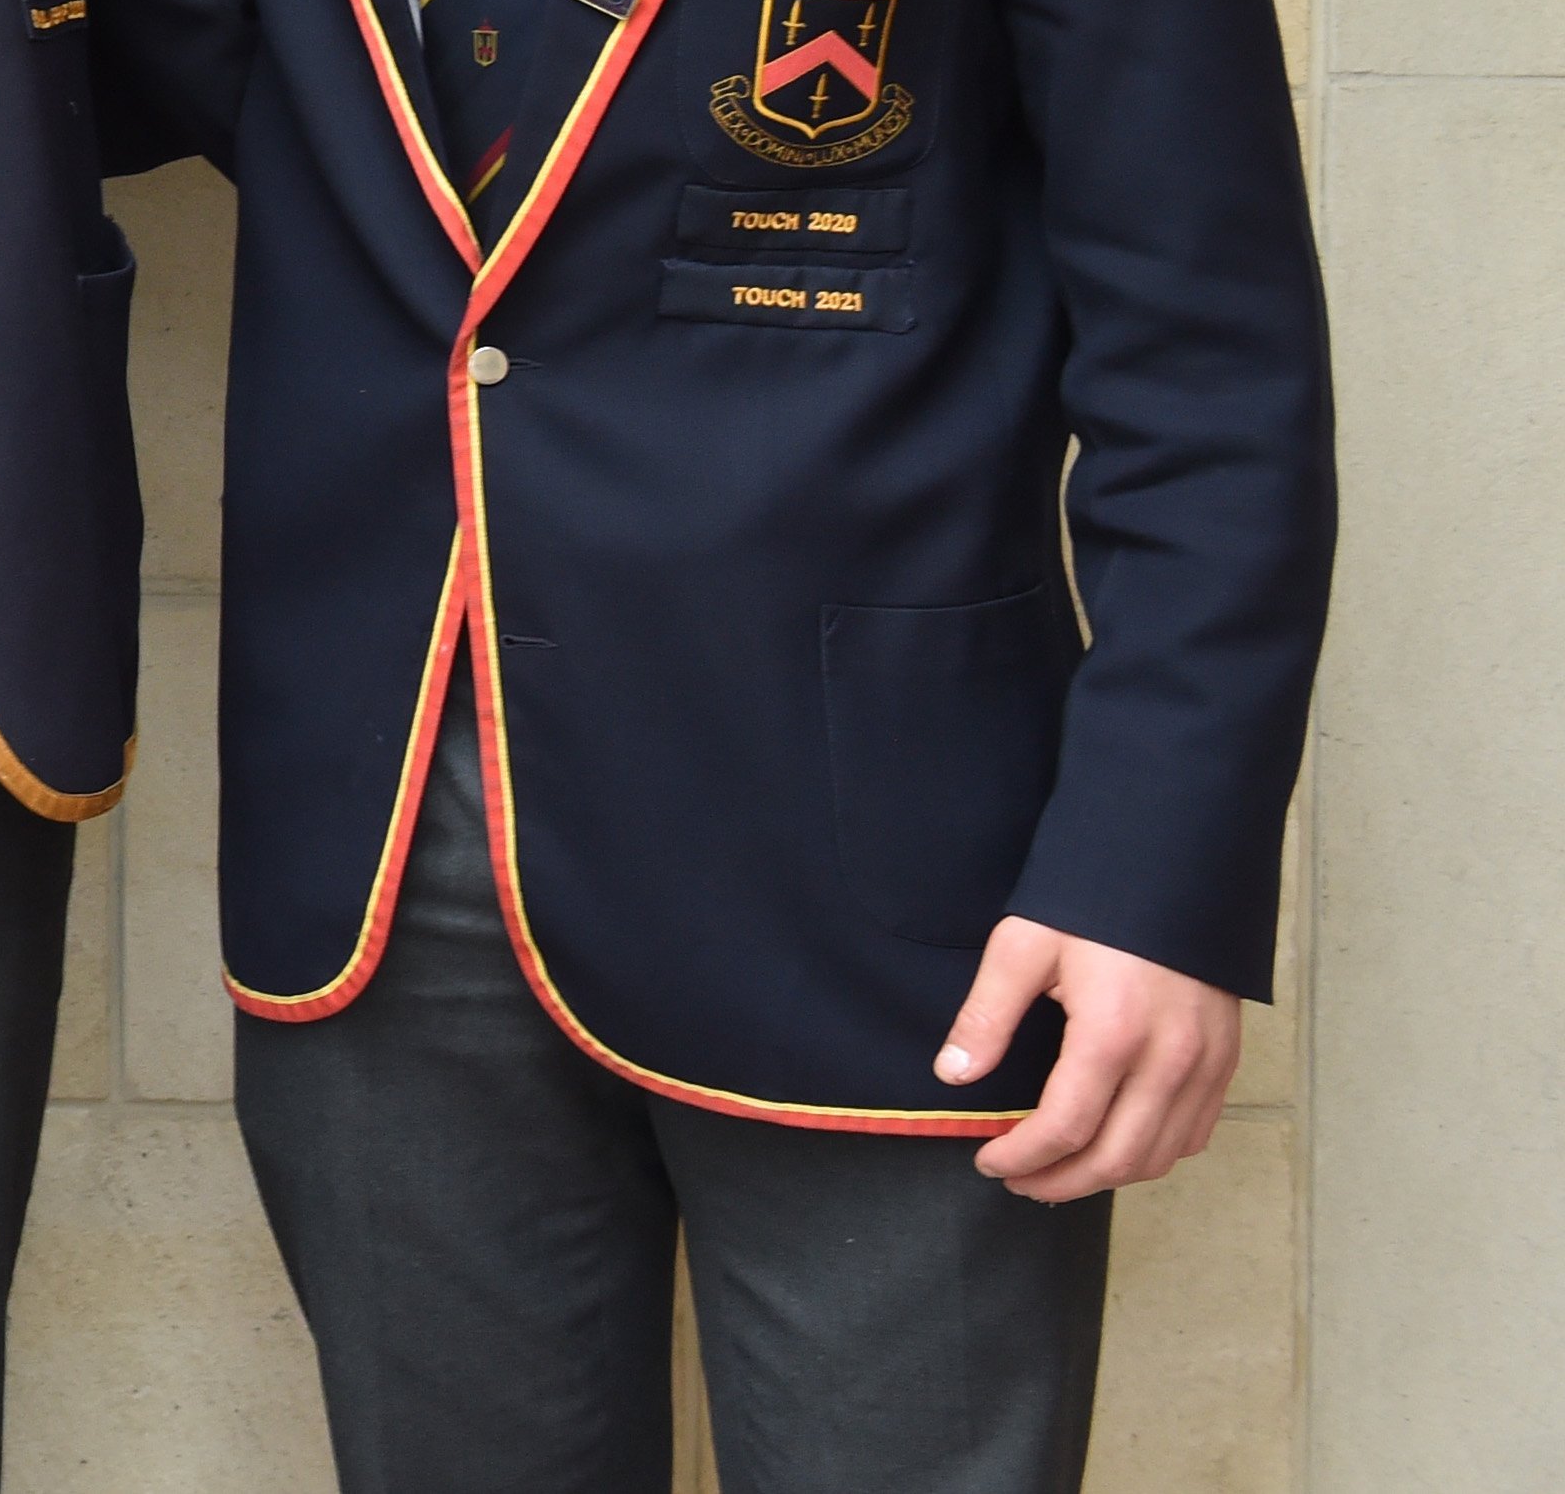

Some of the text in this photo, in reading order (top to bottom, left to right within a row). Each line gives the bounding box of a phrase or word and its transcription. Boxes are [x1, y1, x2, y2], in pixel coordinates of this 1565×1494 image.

[731, 211, 858, 233] TOUCH 2020
[731, 286, 863, 312] TOUCH 2021
